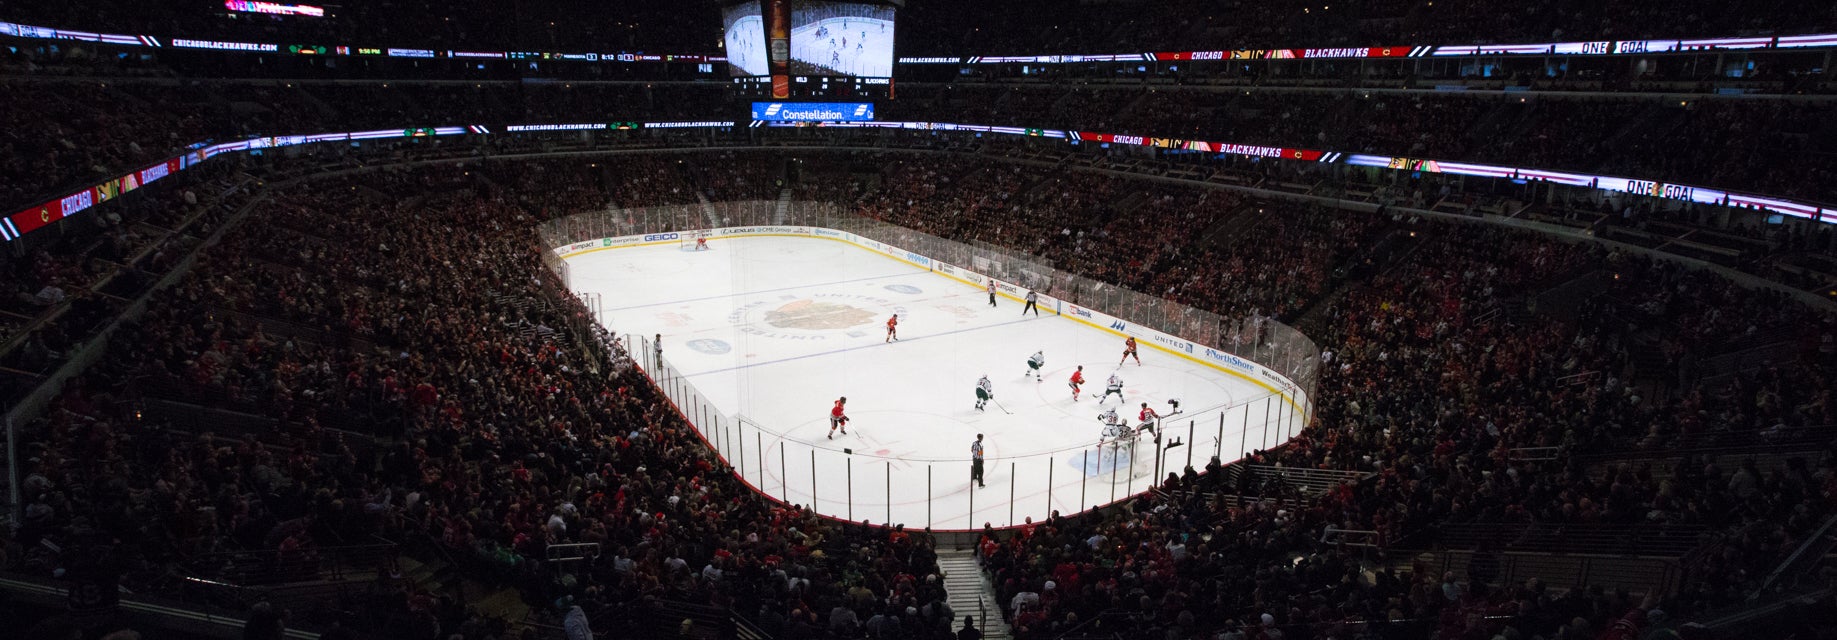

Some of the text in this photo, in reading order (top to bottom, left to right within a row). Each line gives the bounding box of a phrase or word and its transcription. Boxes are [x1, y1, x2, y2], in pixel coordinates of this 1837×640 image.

[172, 38, 278, 51] CHICAGOBLACKHAWKS.COM
[1582, 40, 1648, 54] ONE GOAL
[1191, 51, 1223, 60] CHICAGO
[1304, 48, 1369, 58] BLACKHAWKS
[782, 109, 843, 120] Constellation
[1113, 134, 1143, 145] CHICAGO
[1220, 143, 1282, 158] BLACKHAWKS
[1626, 180, 1695, 201] ONE GOAL
[61, 190, 92, 217] CHICAGO
[644, 233, 679, 242] GEICO
[1154, 335, 1184, 350] UNITED
[1210, 348, 1254, 373] NorthShore
